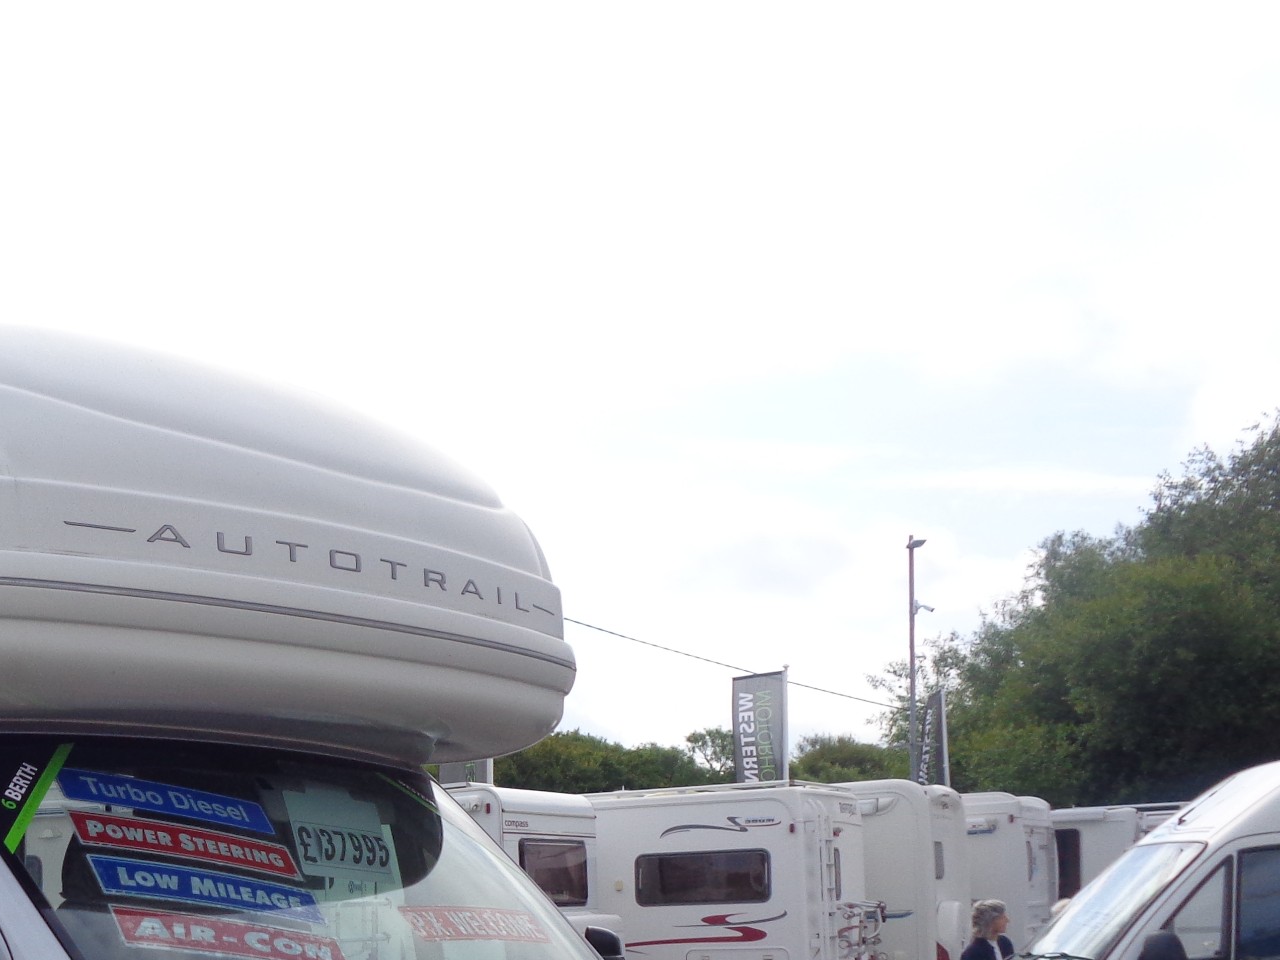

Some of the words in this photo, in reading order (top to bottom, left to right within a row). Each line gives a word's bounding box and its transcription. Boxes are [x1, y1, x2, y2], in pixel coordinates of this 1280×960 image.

[146, 523, 531, 613] AUTOTRAIL
[4, 762, 38, 801] BERTH
[79, 776, 164, 805] Turbo
[167, 790, 250, 823] Diesel
[1, 798, 17, 810] 6
[85, 819, 173, 847] POWER
[179, 833, 285, 868] STEERING
[117, 866, 179, 891] LOW
[190, 876, 302, 909] MILEAGE
[443, 909, 548, 941] WELCOME
